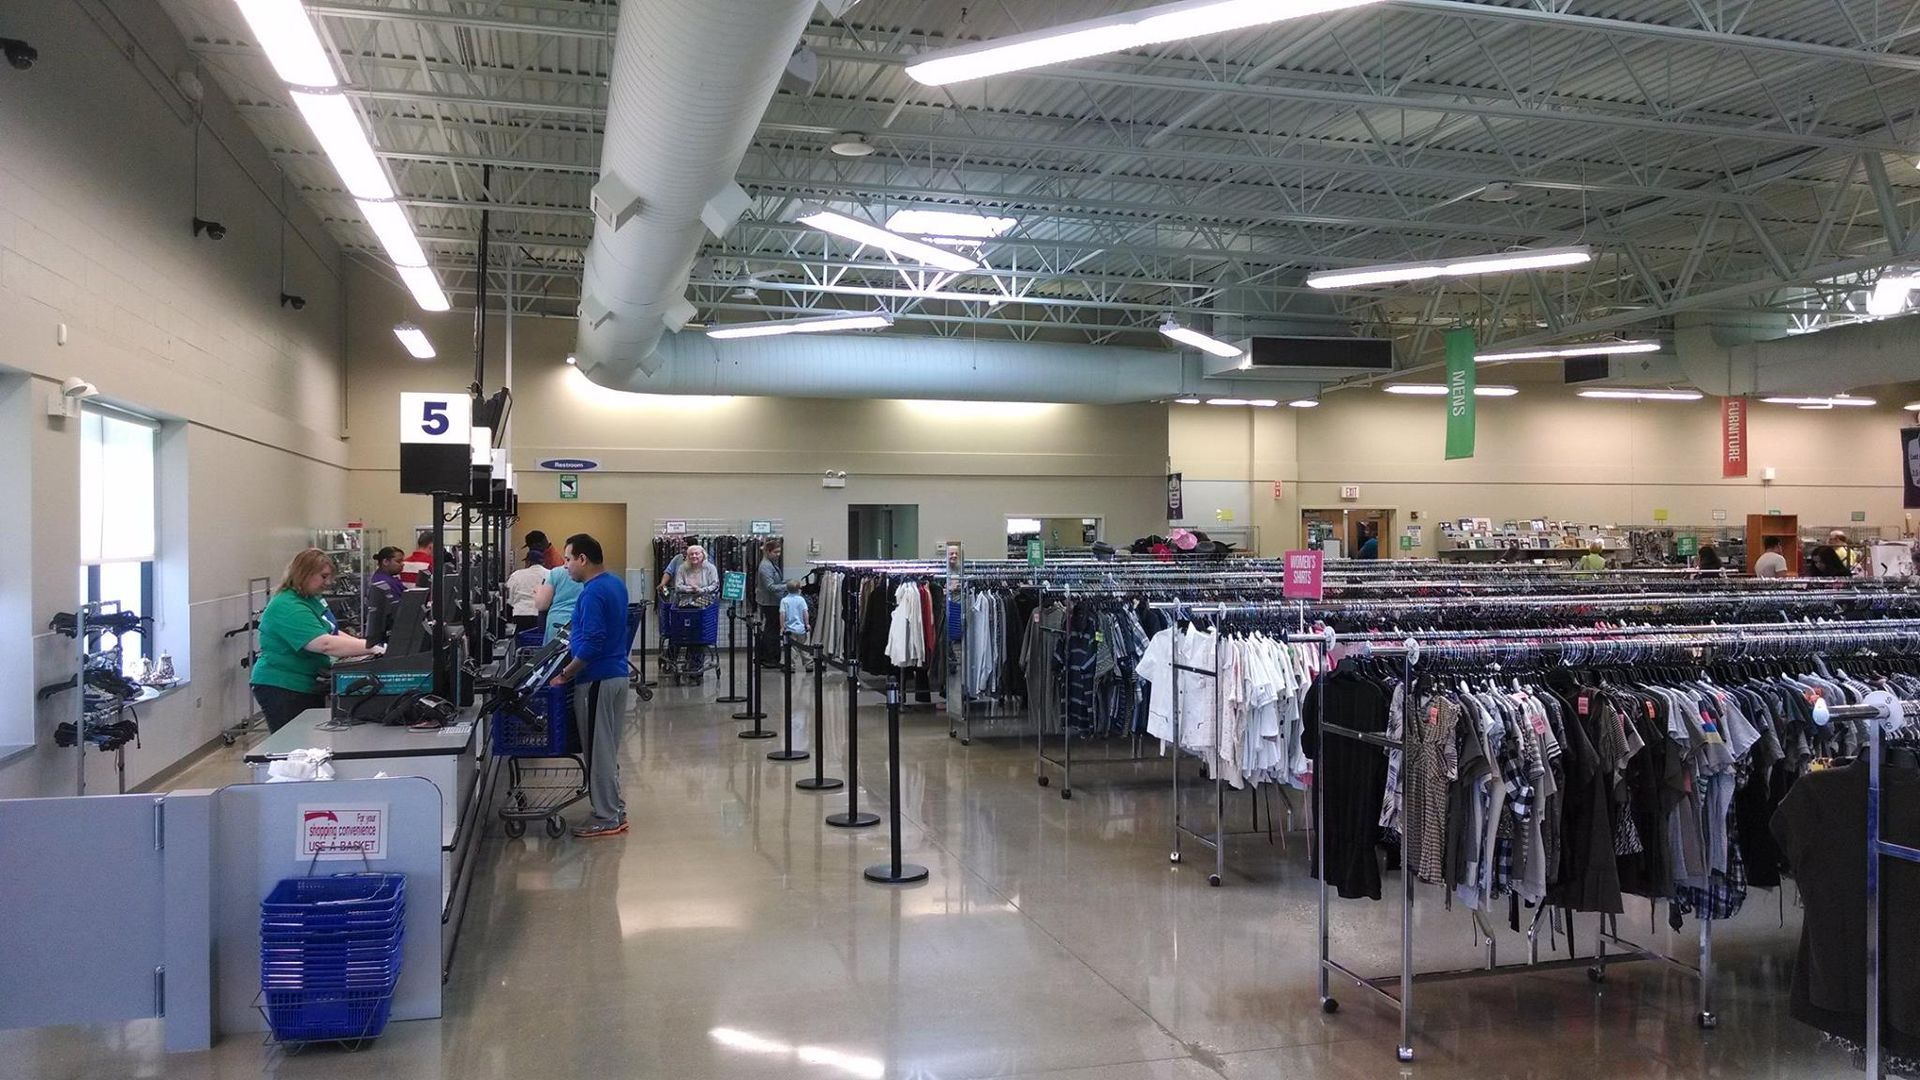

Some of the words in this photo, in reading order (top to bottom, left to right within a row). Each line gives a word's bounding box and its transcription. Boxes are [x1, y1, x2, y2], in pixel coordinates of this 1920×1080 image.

[1452, 370, 1466, 417] MENS
[421, 401, 450, 436] 5
[1728, 401, 1740, 463] FURNITURE
[554, 461, 584, 469] Restroom
[1346, 487, 1357, 497] EXIT
[1290, 554, 1316, 569] WOMEN'S
[1293, 570, 1312, 585] SHIRTS
[356, 813, 364, 823] For
[366, 814, 376, 824] your
[309, 823, 337, 840] shopping
[338, 824, 376, 836] convenience
[309, 841, 326, 852] USE
[329, 841, 337, 852] A
[339, 840, 376, 851] BASKET
